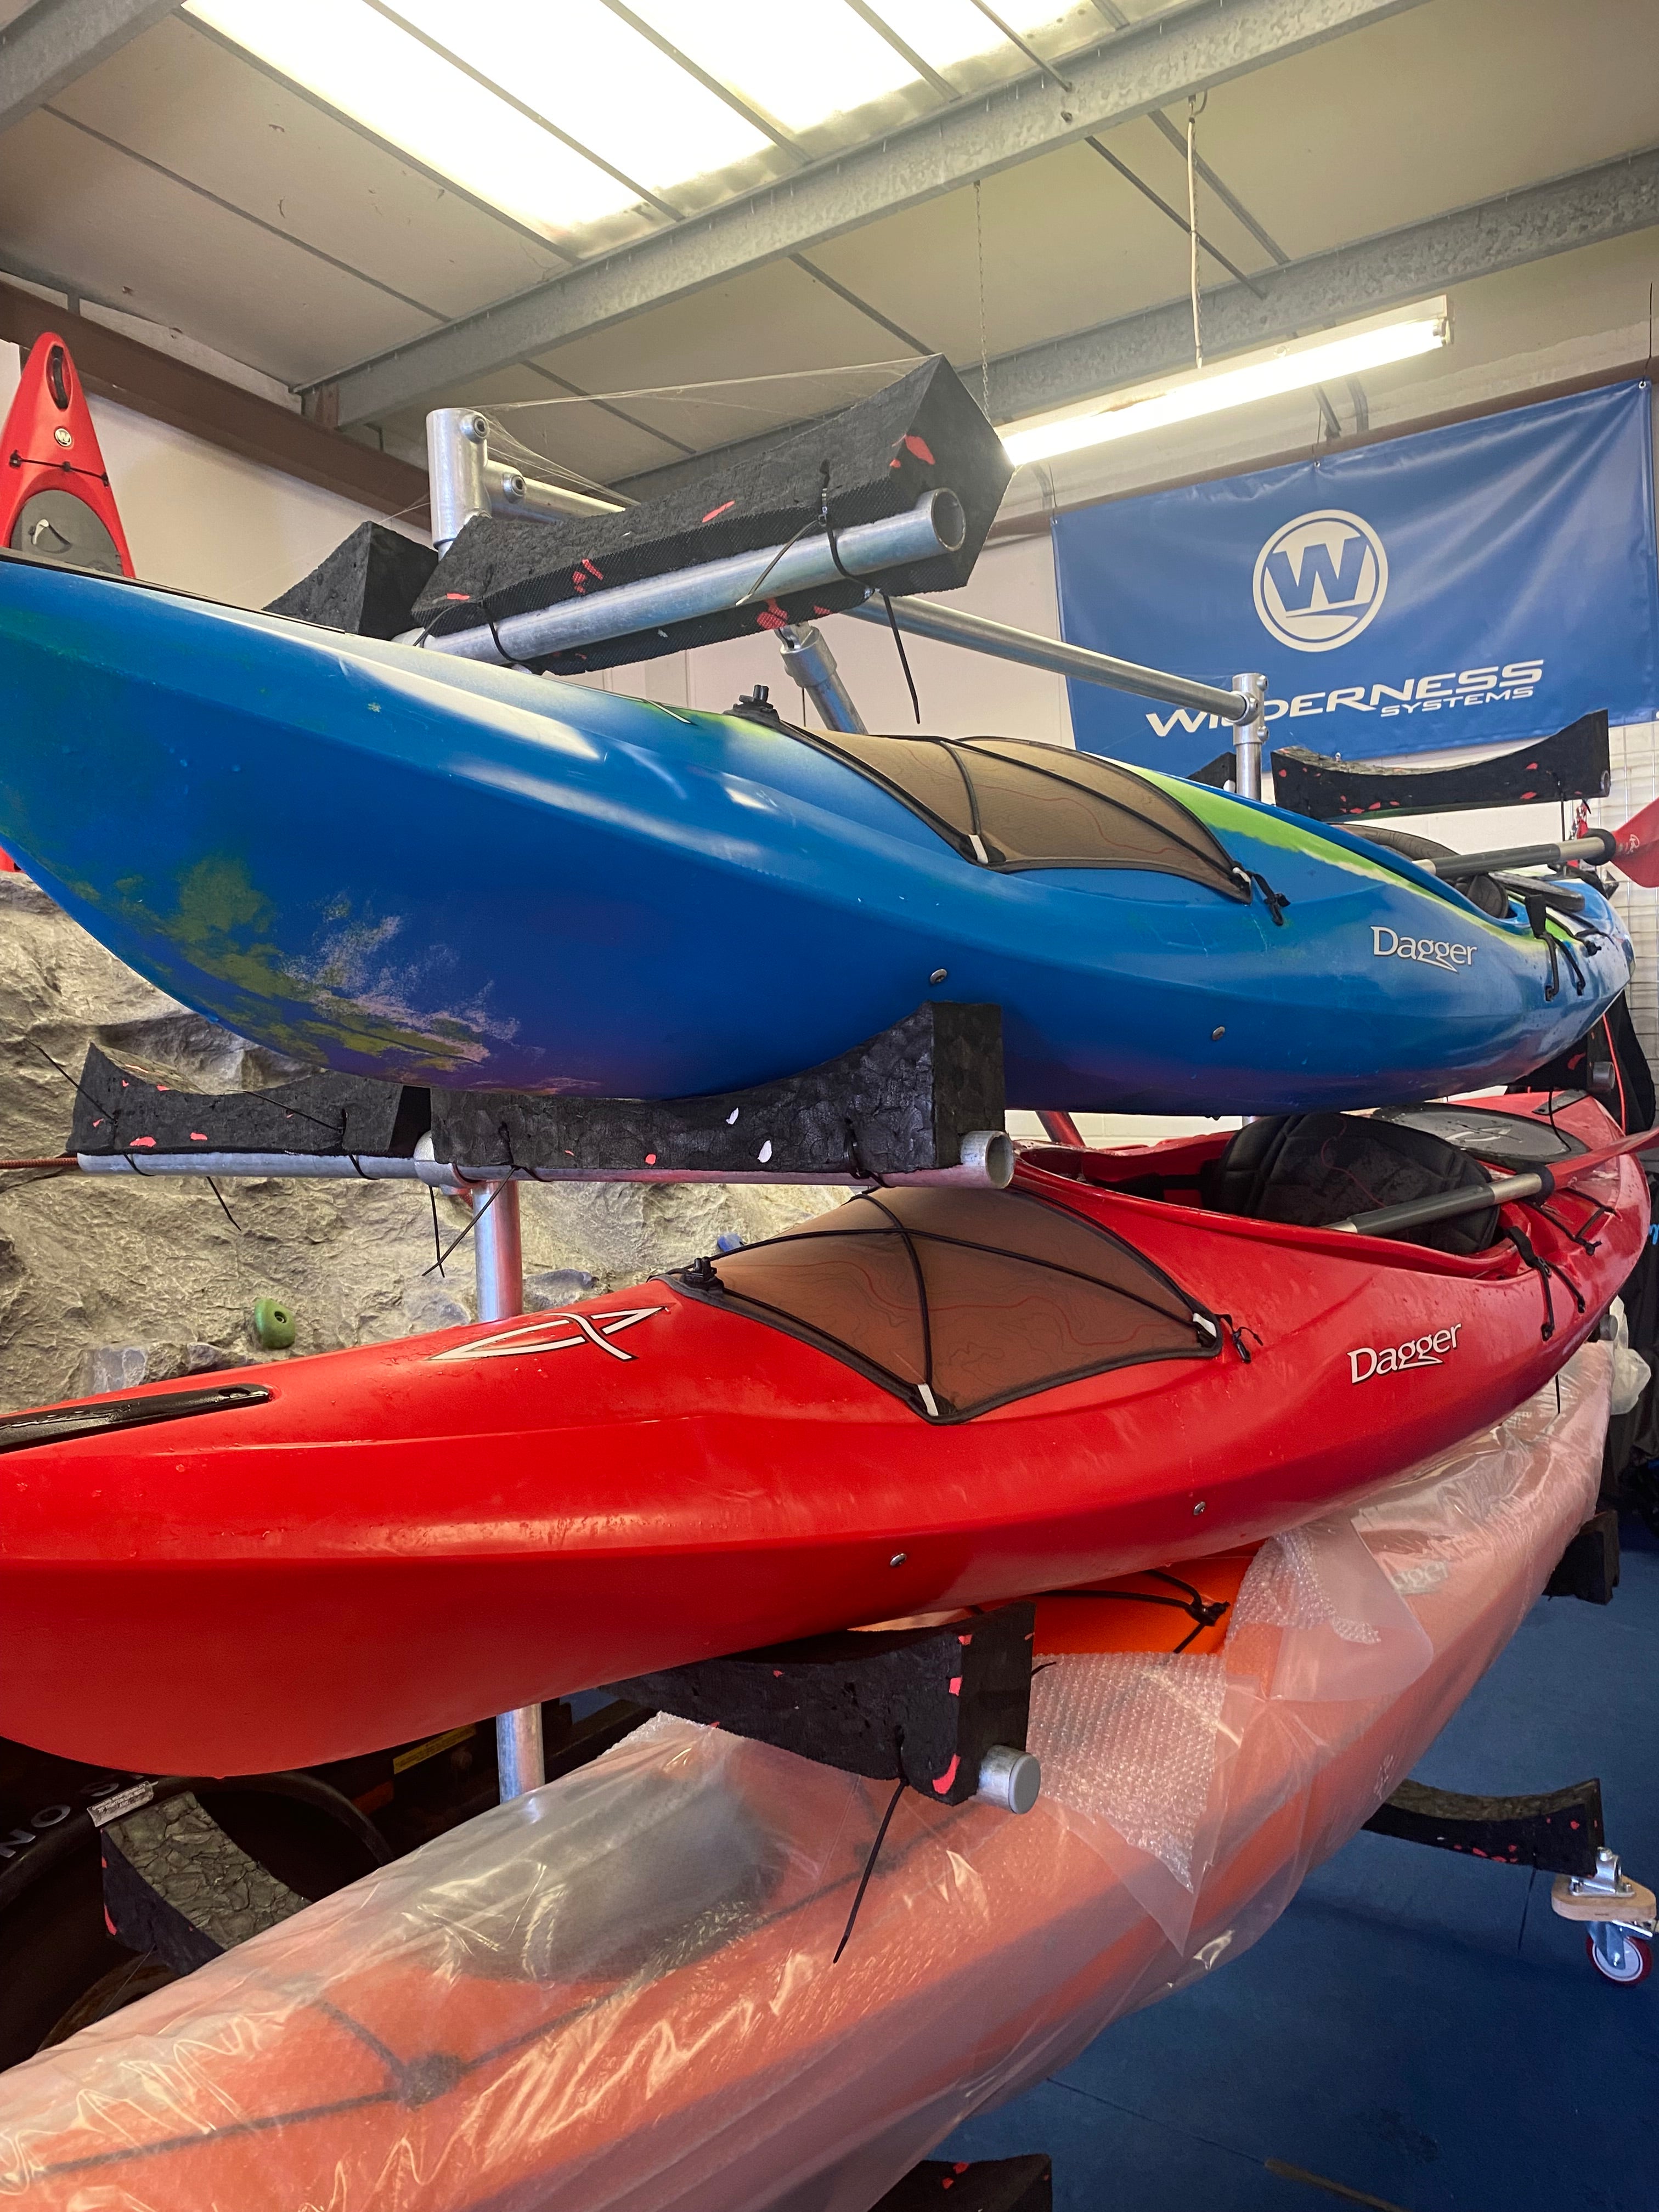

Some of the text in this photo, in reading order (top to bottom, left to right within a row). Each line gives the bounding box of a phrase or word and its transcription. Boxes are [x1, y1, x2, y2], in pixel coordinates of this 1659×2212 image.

[1265, 534, 1368, 613] W
[1146, 659, 1544, 737] WIDERNESS
[1380, 685, 1534, 718] SYSTEMS
[1370, 926, 1478, 973] Dagger
[1347, 1323, 1462, 1384] Dagger
